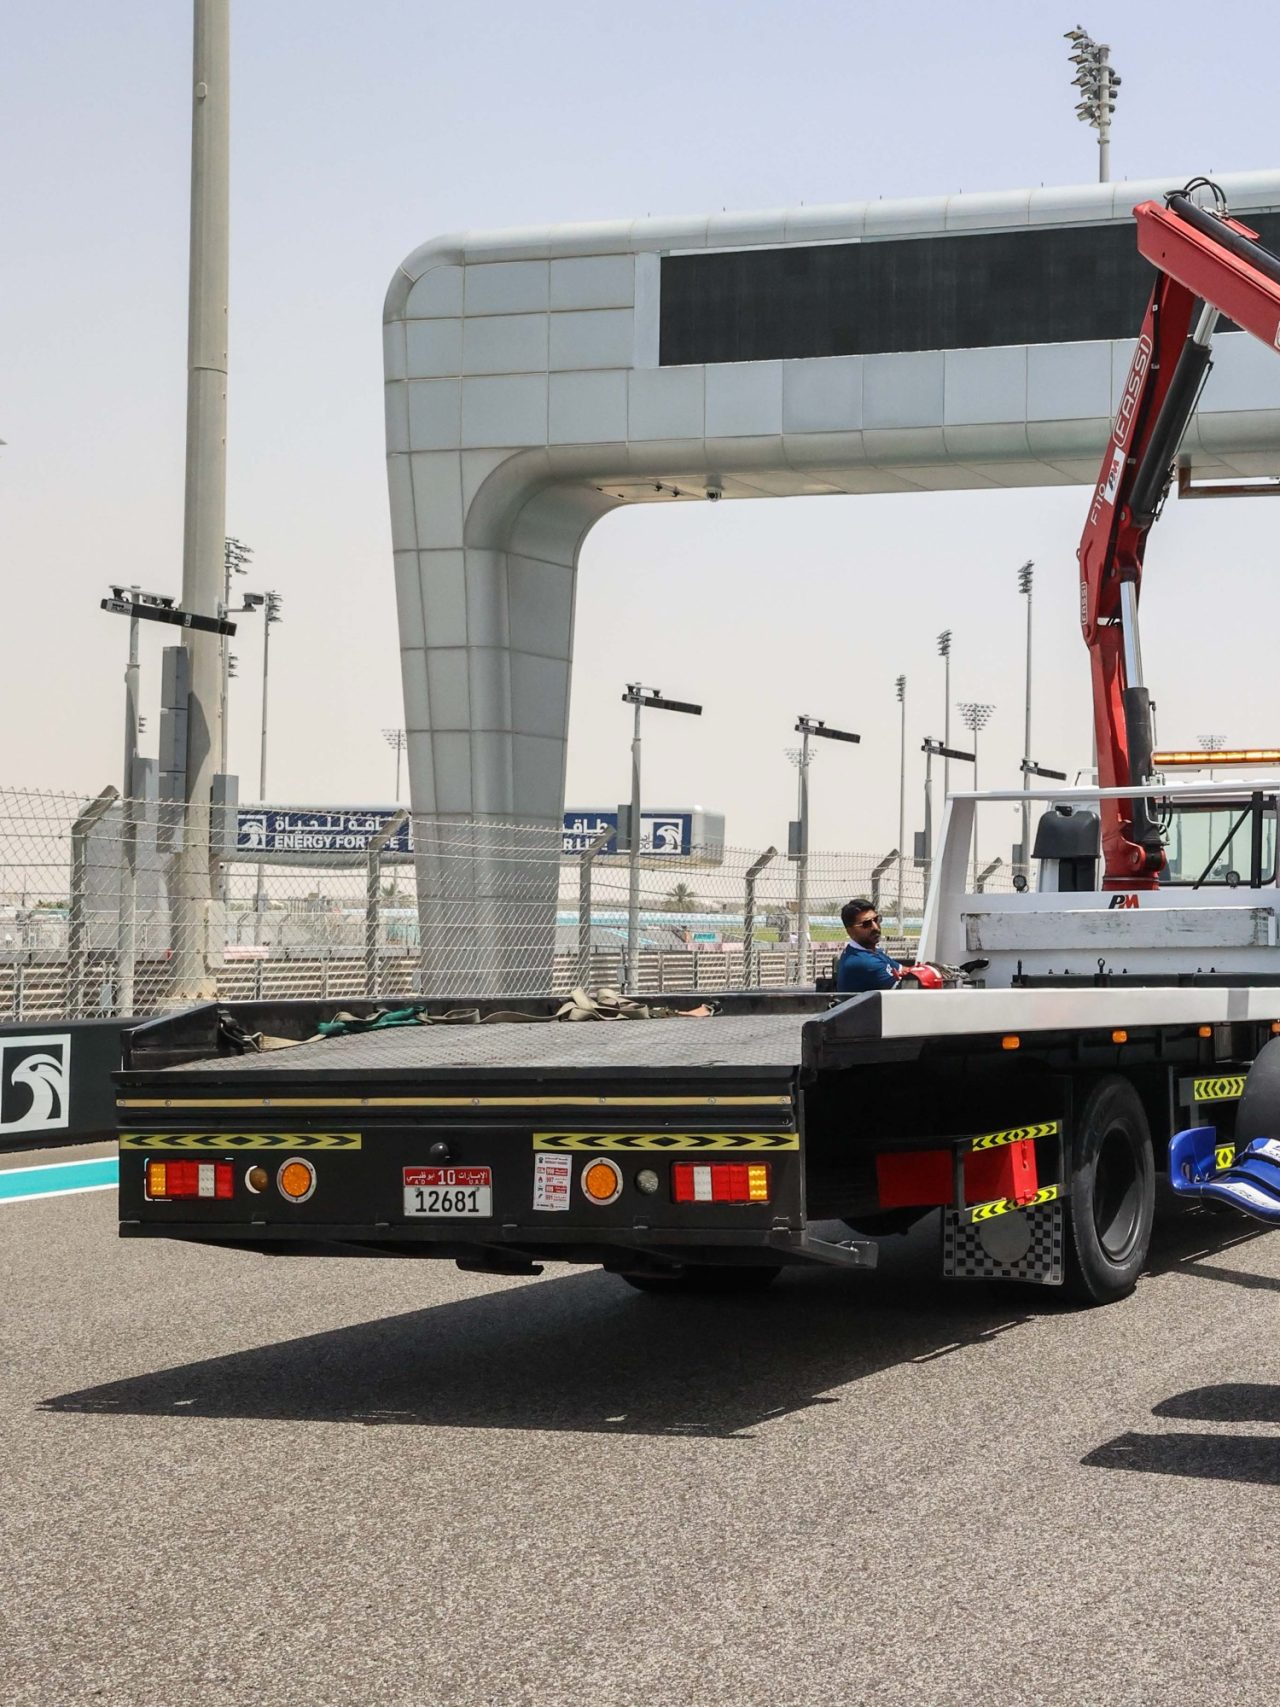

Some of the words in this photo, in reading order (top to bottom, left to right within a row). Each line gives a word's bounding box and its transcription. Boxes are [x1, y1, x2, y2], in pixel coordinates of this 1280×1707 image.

[1114, 341, 1151, 440] FASSI
[1090, 483, 1106, 526] F110
[274, 835, 331, 849] ENERGY
[336, 836, 366, 849] FOR
[1108, 894, 1140, 909] PM
[438, 1170, 456, 1185] 10
[415, 1190, 479, 1213] 12681
